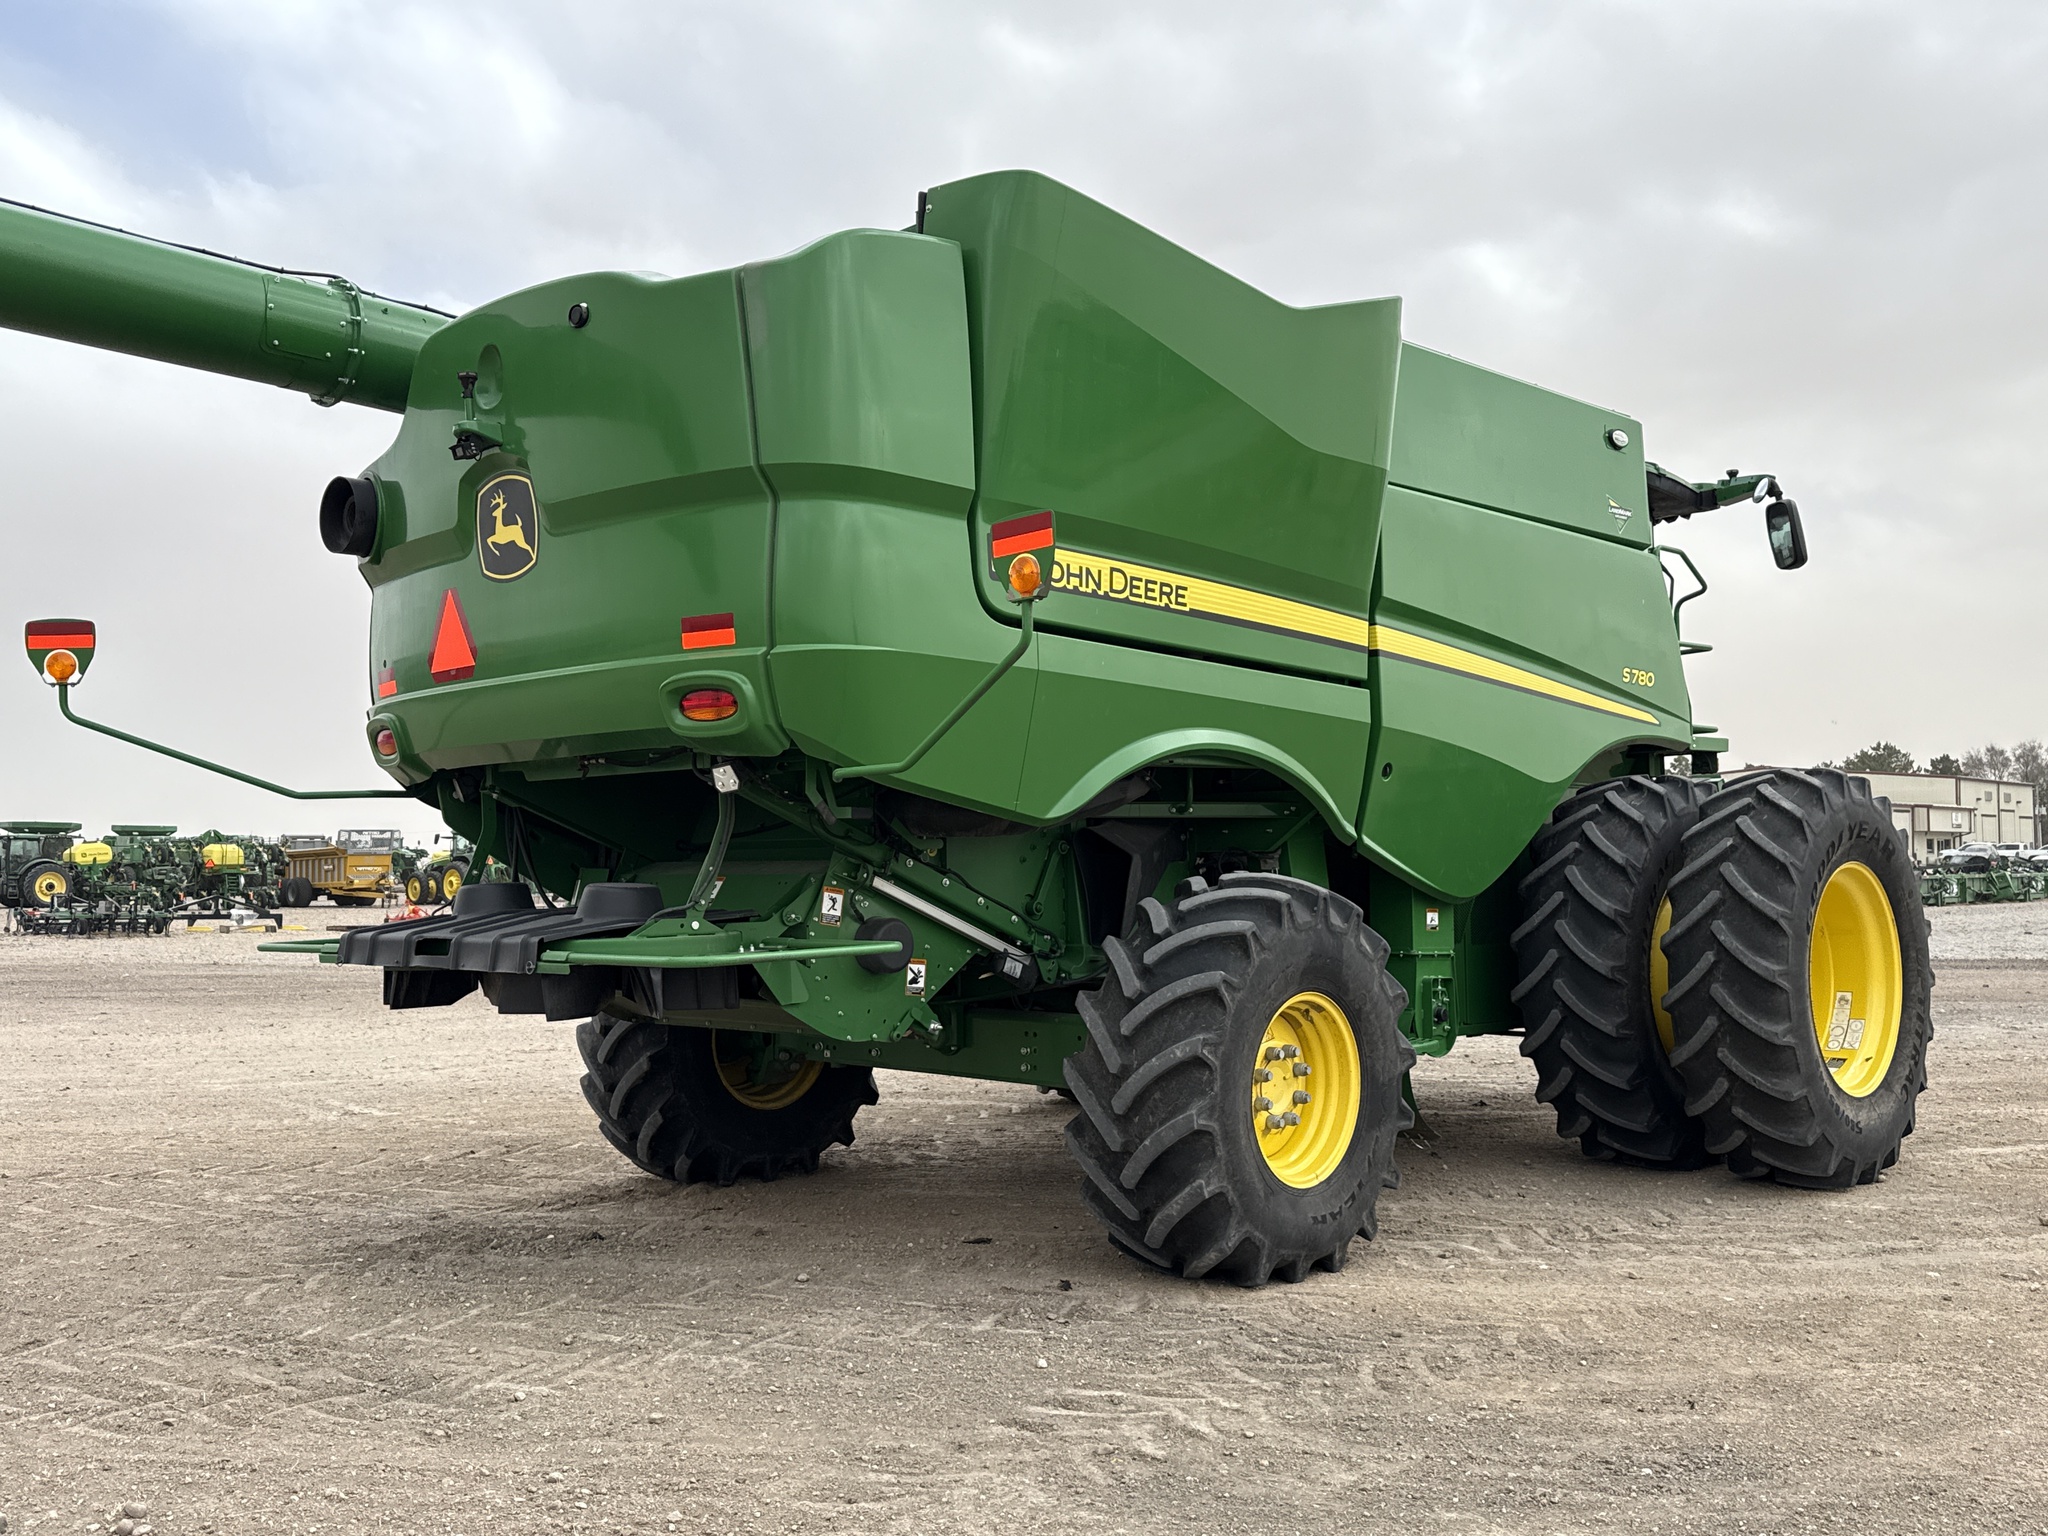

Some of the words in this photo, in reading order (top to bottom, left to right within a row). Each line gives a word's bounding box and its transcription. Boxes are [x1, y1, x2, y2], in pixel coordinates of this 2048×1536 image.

[1051, 560, 1102, 592] OHN
[1109, 566, 1189, 608] DEERE
[1622, 667, 1655, 688] S780
